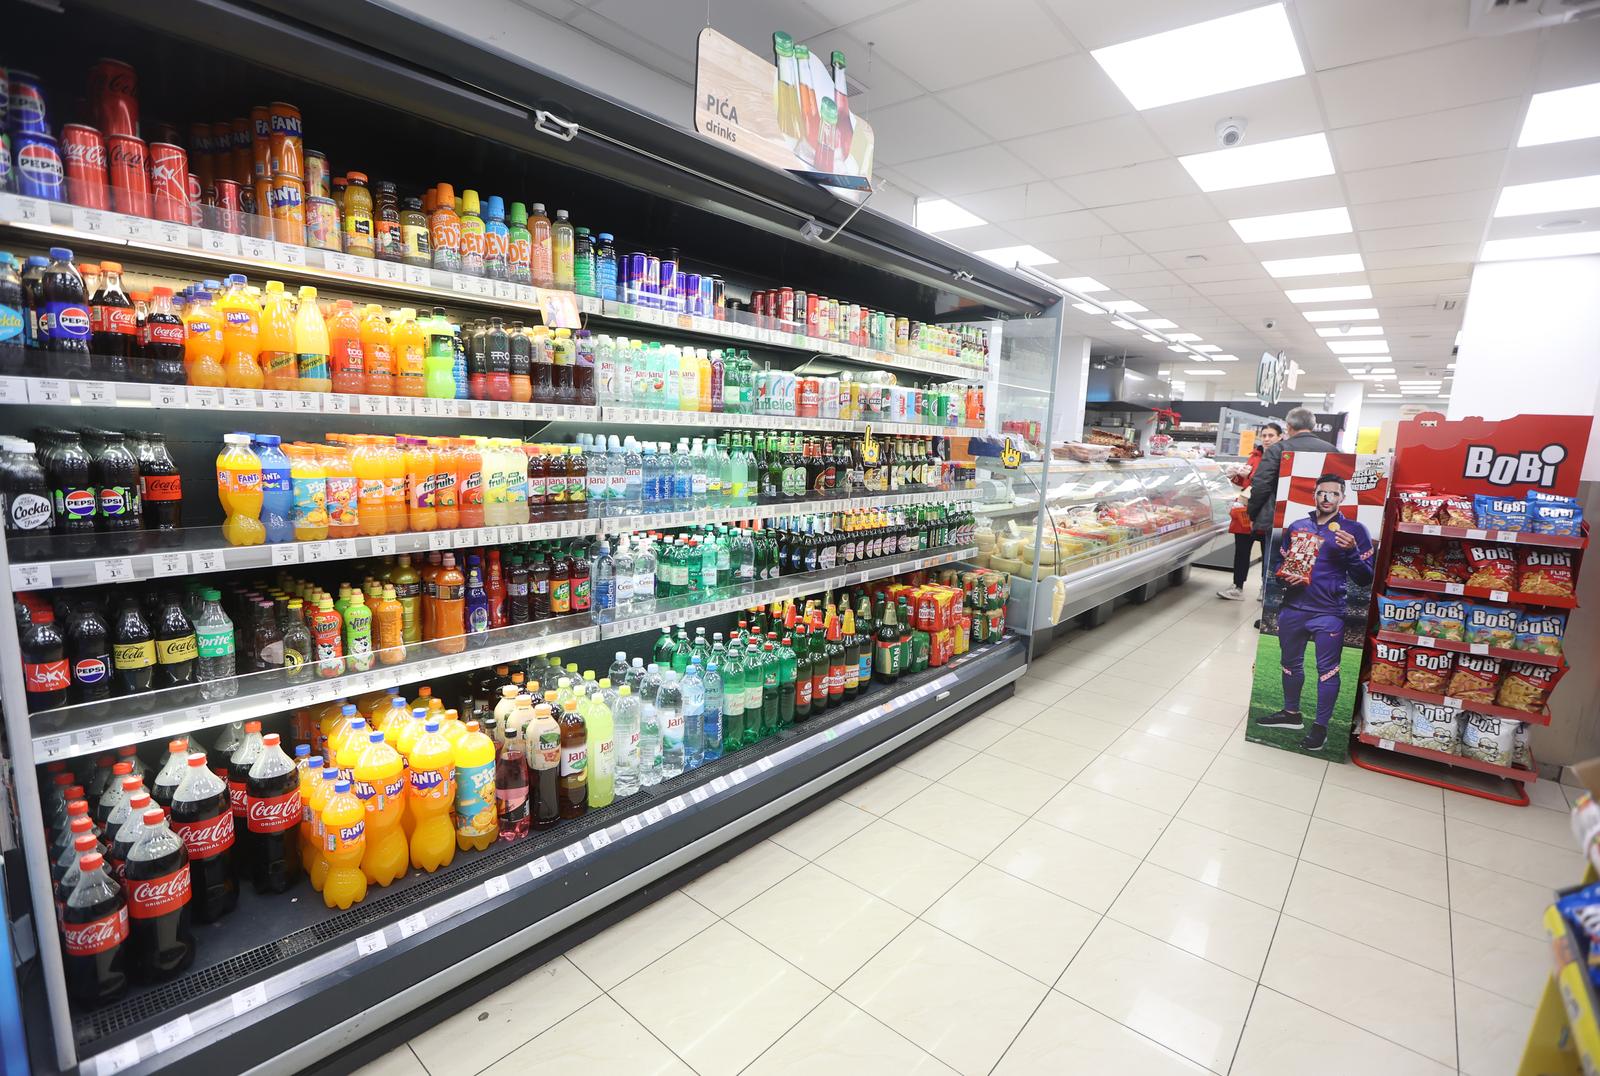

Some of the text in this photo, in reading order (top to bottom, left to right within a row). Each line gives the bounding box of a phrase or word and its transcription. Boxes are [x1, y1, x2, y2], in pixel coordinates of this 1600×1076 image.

[707, 94, 739, 124] PIĆA
[272, 116, 302, 133] FANT
[706, 120, 737, 143] drinks
[20, 158, 62, 175] PEPSI
[61, 316, 89, 326] PEPSI
[226, 312, 251, 322] FANTA
[435, 477, 455, 489] ruits
[532, 479, 545, 487] Jan
[548, 478, 564, 486] Jana
[67, 499, 96, 507] PEPSI
[14, 502, 50, 520] Cockta
[37, 670, 65, 683] SKY
[77, 666, 104, 675] PEPSI
[600, 741, 614, 753] Jan
[409, 770, 443, 785] FANTA
[385, 779, 404, 795] FANT
[260, 816, 289, 827] ORIGINAL
[340, 820, 365, 840] FANT
[145, 897, 174, 908] ORIGINAL
